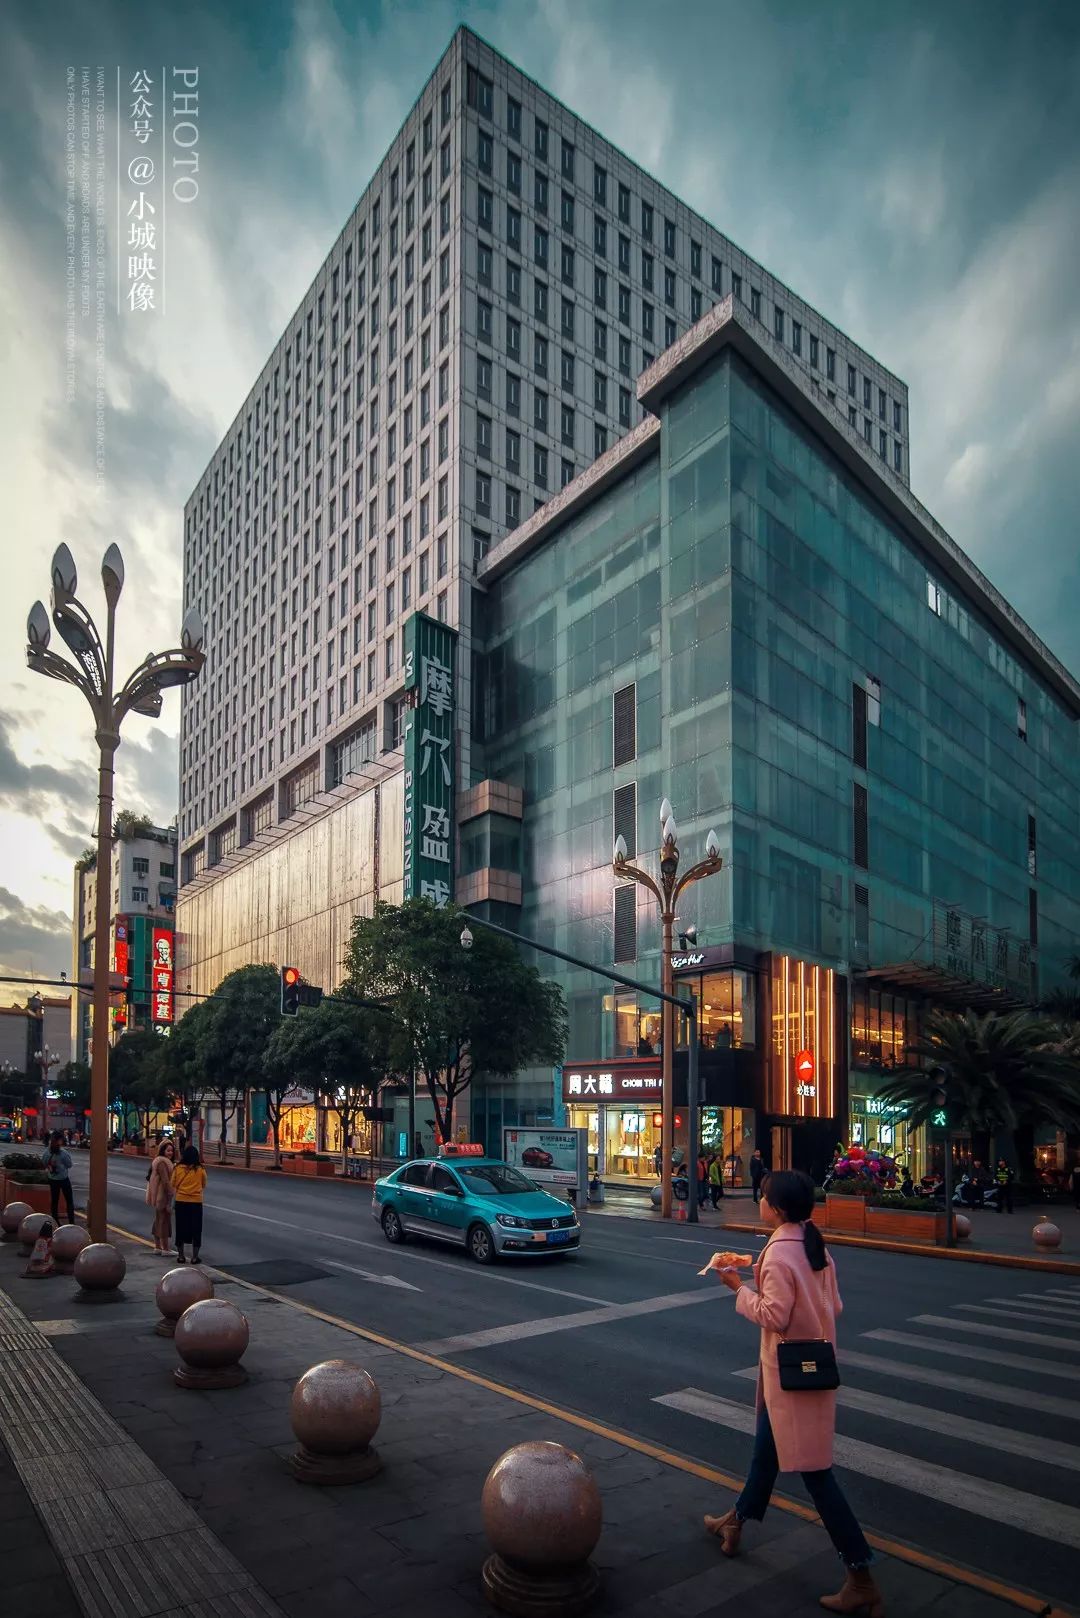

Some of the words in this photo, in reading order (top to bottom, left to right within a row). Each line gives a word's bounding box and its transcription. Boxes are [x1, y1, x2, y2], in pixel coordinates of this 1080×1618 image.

[157, 972, 170, 1019] 肯德基
[568, 1074, 612, 1094] 周大福
[622, 1078, 642, 1088] CHOW
[644, 1078, 656, 1088] TAI
[796, 1084, 816, 1097] 必胜客
